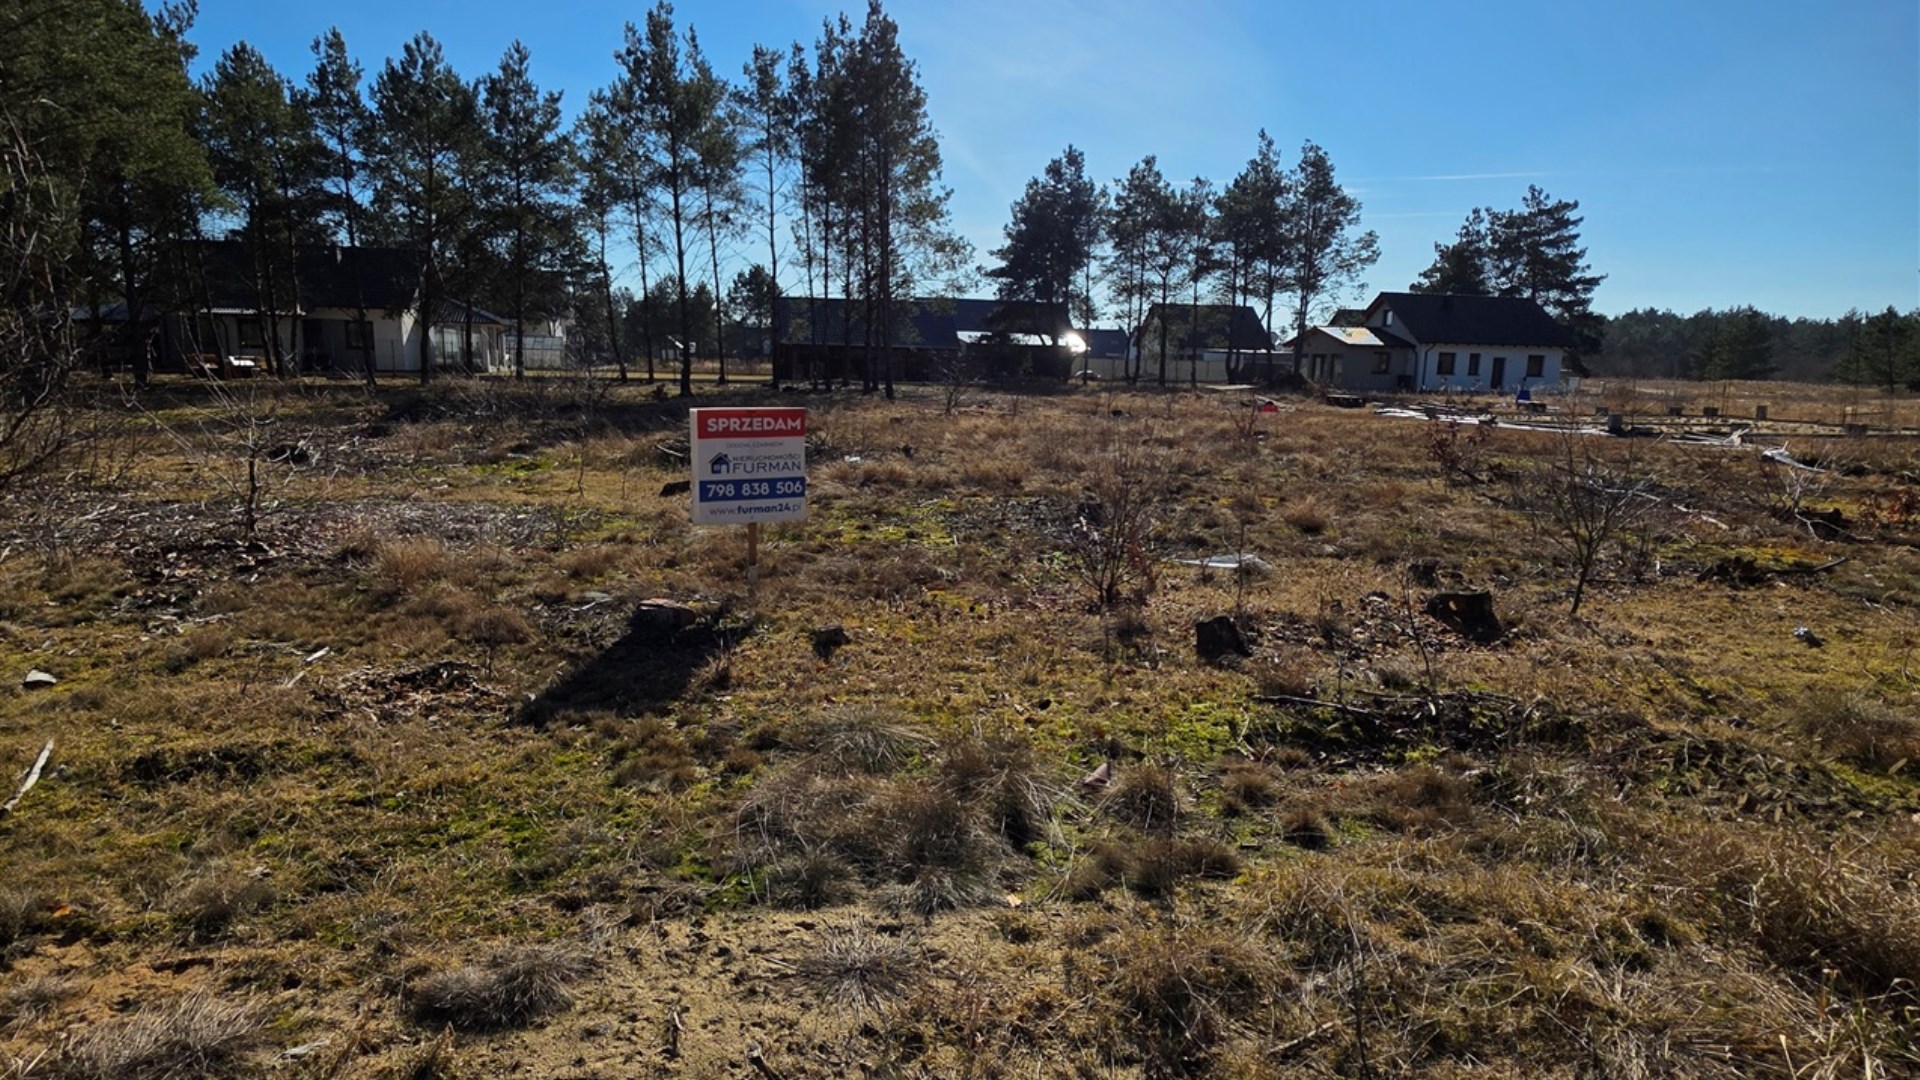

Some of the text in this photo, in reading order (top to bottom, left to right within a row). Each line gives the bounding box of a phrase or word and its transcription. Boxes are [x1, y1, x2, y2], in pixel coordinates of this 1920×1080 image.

[707, 417, 801, 432] SPRZEDAM
[733, 462, 801, 474] FURMAN
[707, 481, 803, 498] 798 838 506
[709, 503, 802, 515] www.furman24.pl
